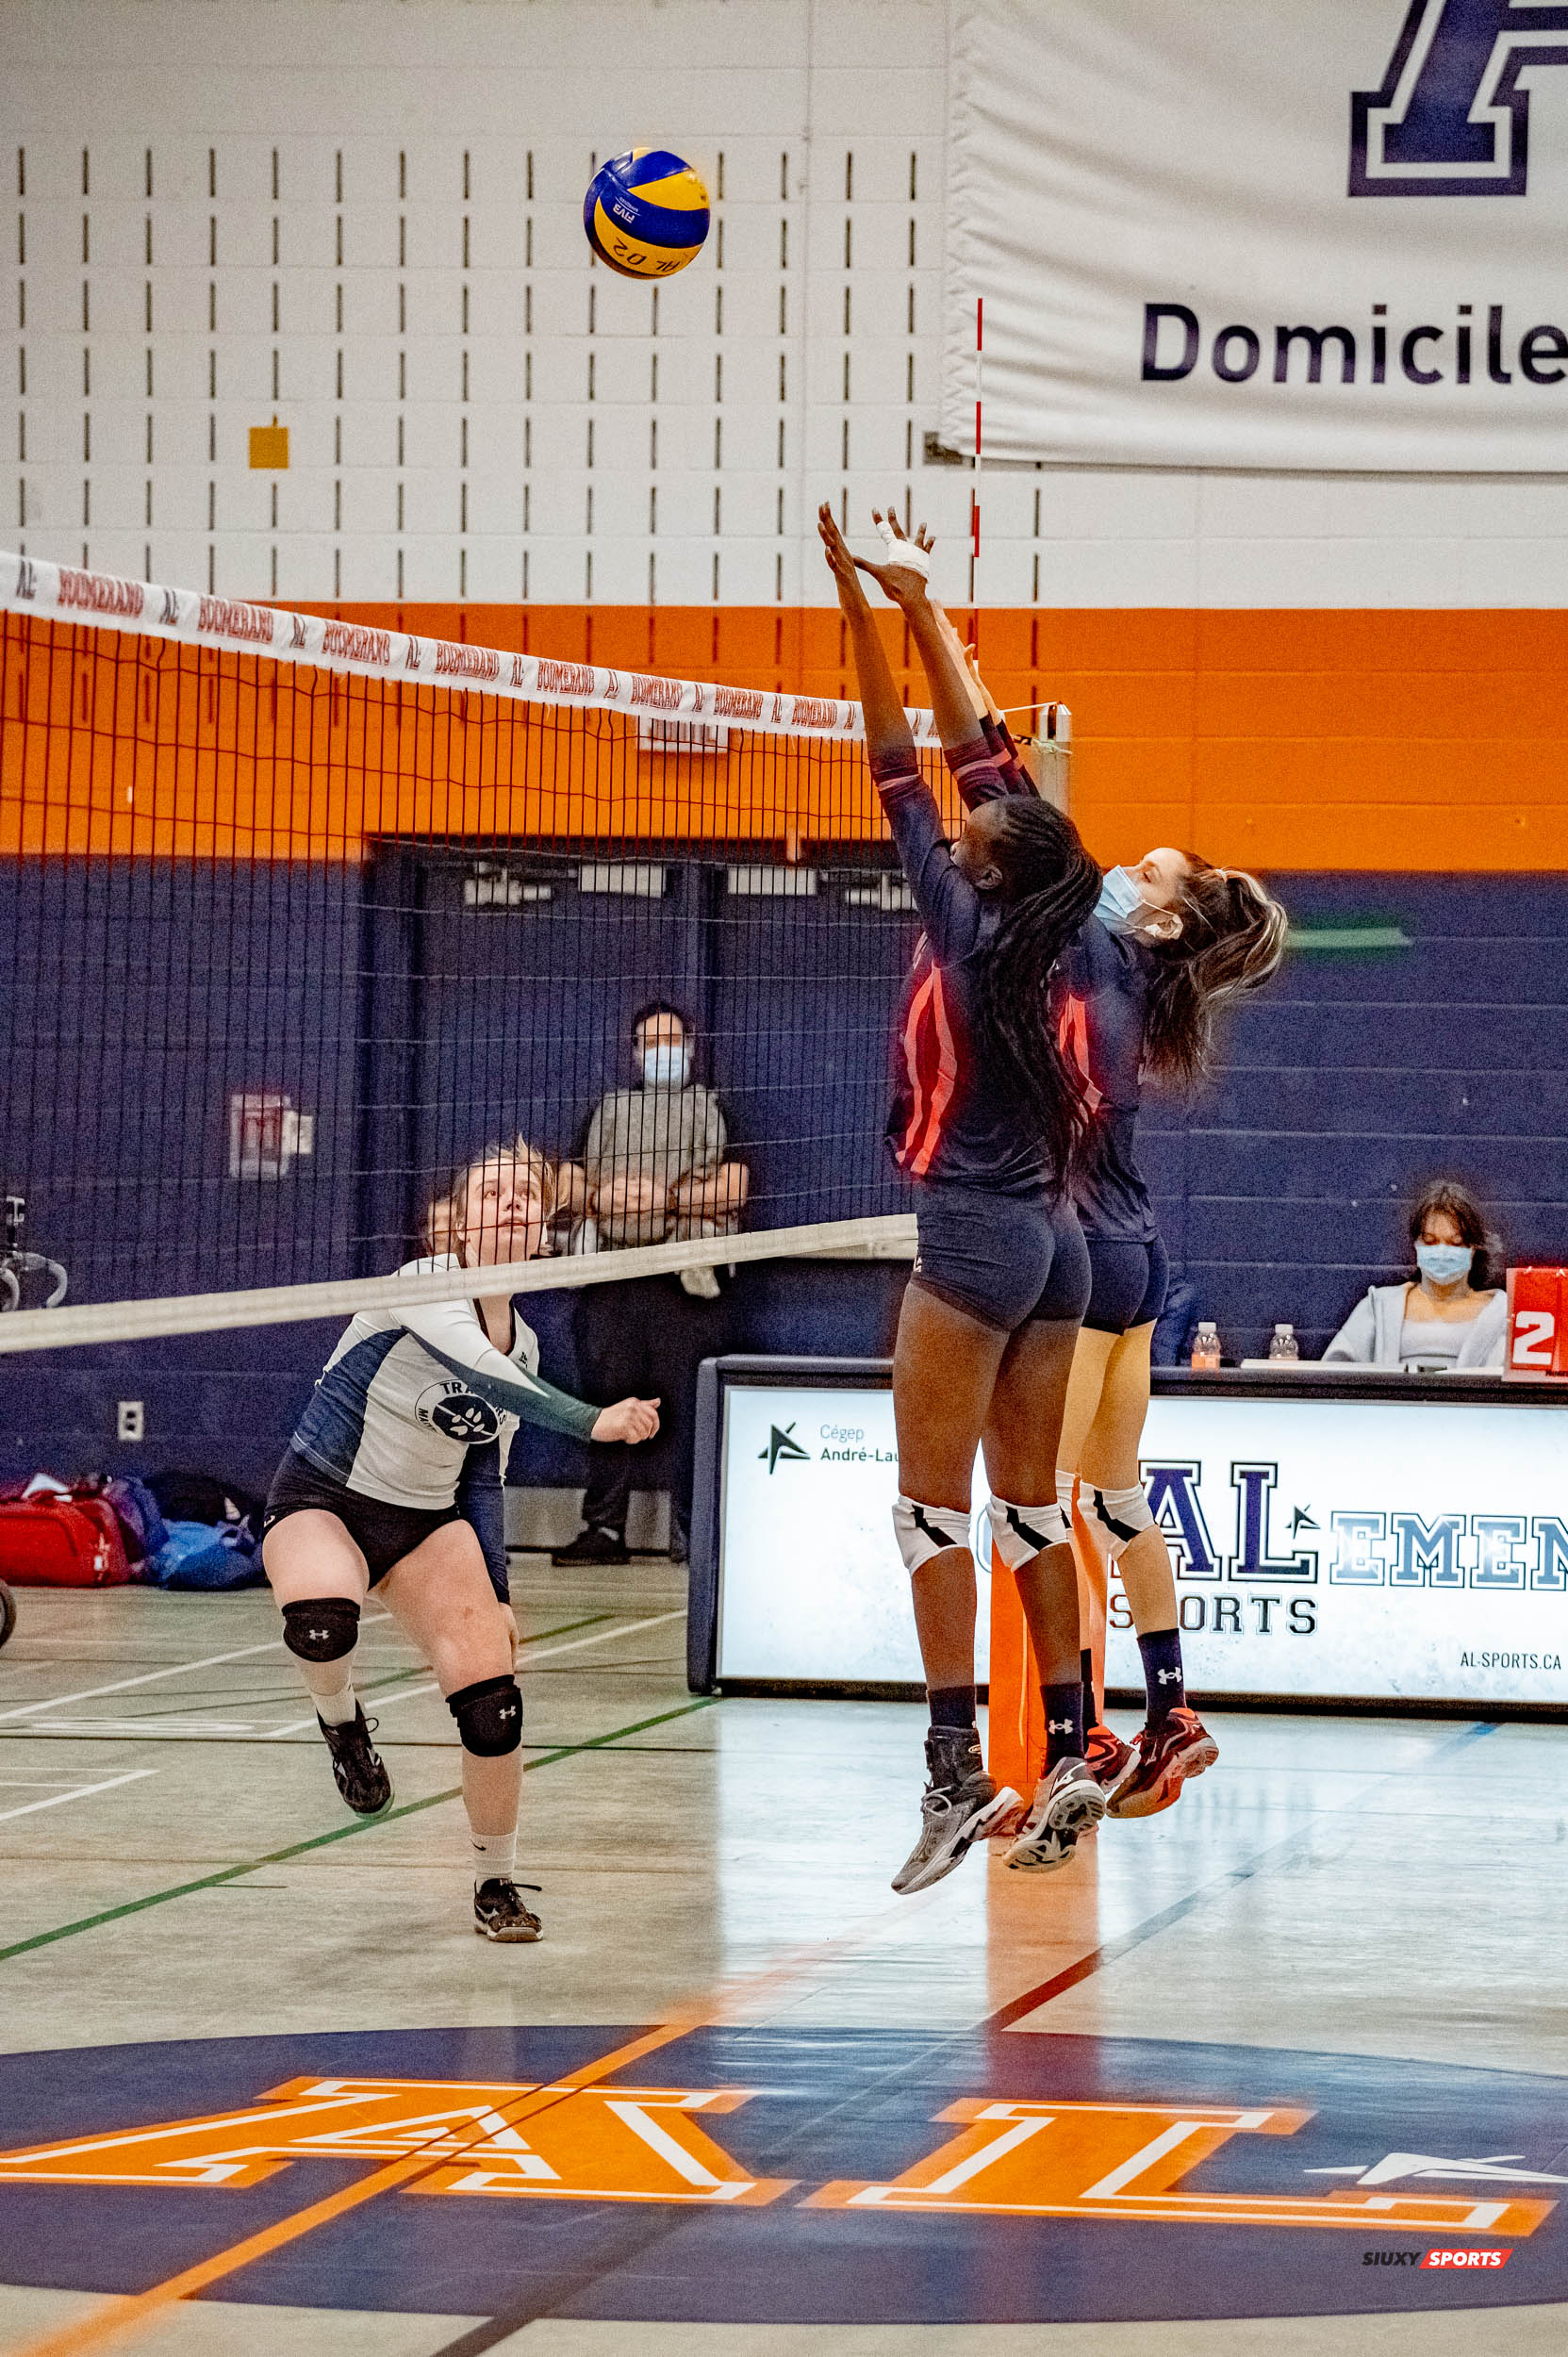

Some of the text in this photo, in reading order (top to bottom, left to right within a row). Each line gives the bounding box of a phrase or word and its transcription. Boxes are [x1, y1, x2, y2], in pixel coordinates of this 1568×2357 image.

[613, 203, 635, 223] FIVB
[1141, 304, 1568, 384] Domicile
[1512, 1310, 1555, 1365] 2
[820, 1424, 865, 1443] Cégep
[1109, 1592, 1318, 1635] SORTS
[1461, 1652, 1561, 1670] AL-SPORTS.CA
